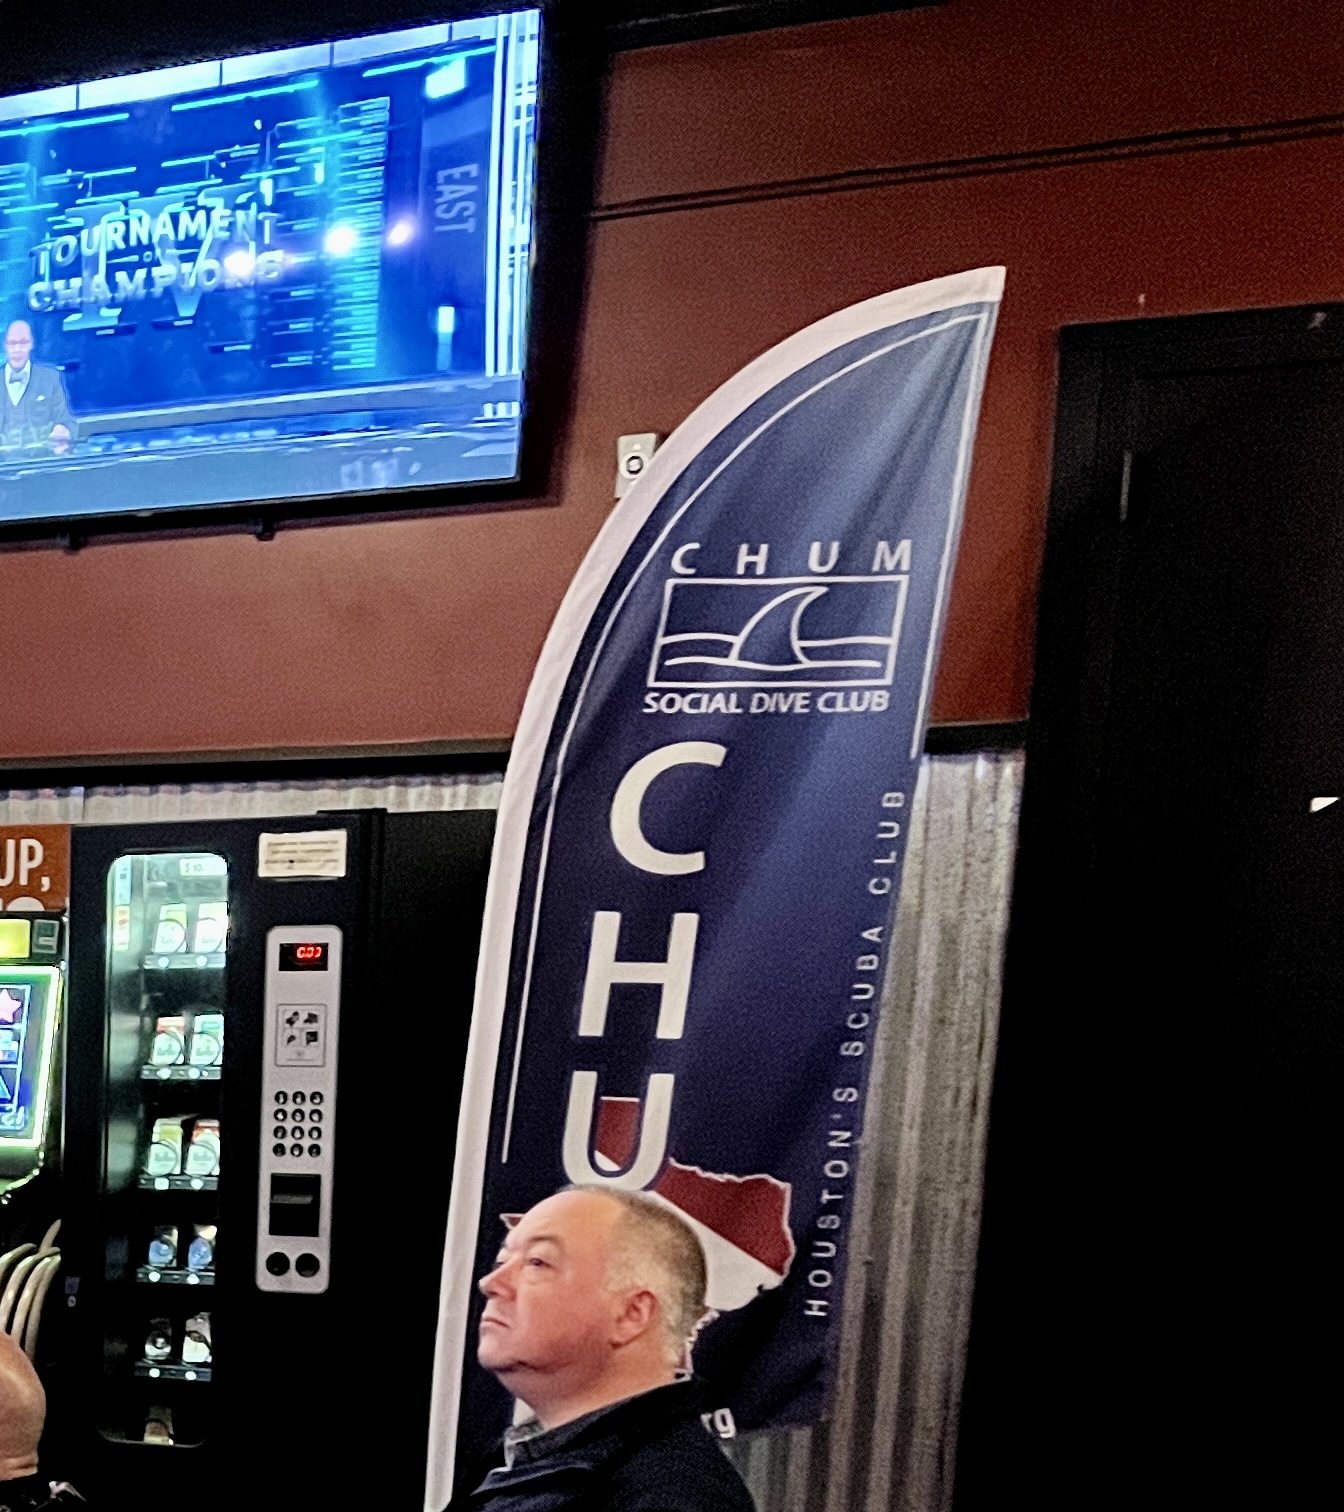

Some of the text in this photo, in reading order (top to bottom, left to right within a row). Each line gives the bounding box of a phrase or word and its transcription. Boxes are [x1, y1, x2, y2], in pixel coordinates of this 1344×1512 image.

[434, 163, 479, 233] EAST
[31, 207, 280, 276] TOURNAMENT
[28, 250, 284, 312] CHAMPIOS
[671, 539, 912, 575] CHUM
[643, 690, 890, 714] SOCIAL DIVE CLUB
[803, 791, 906, 1317] HOUSTON'S SCUBA CLUB
